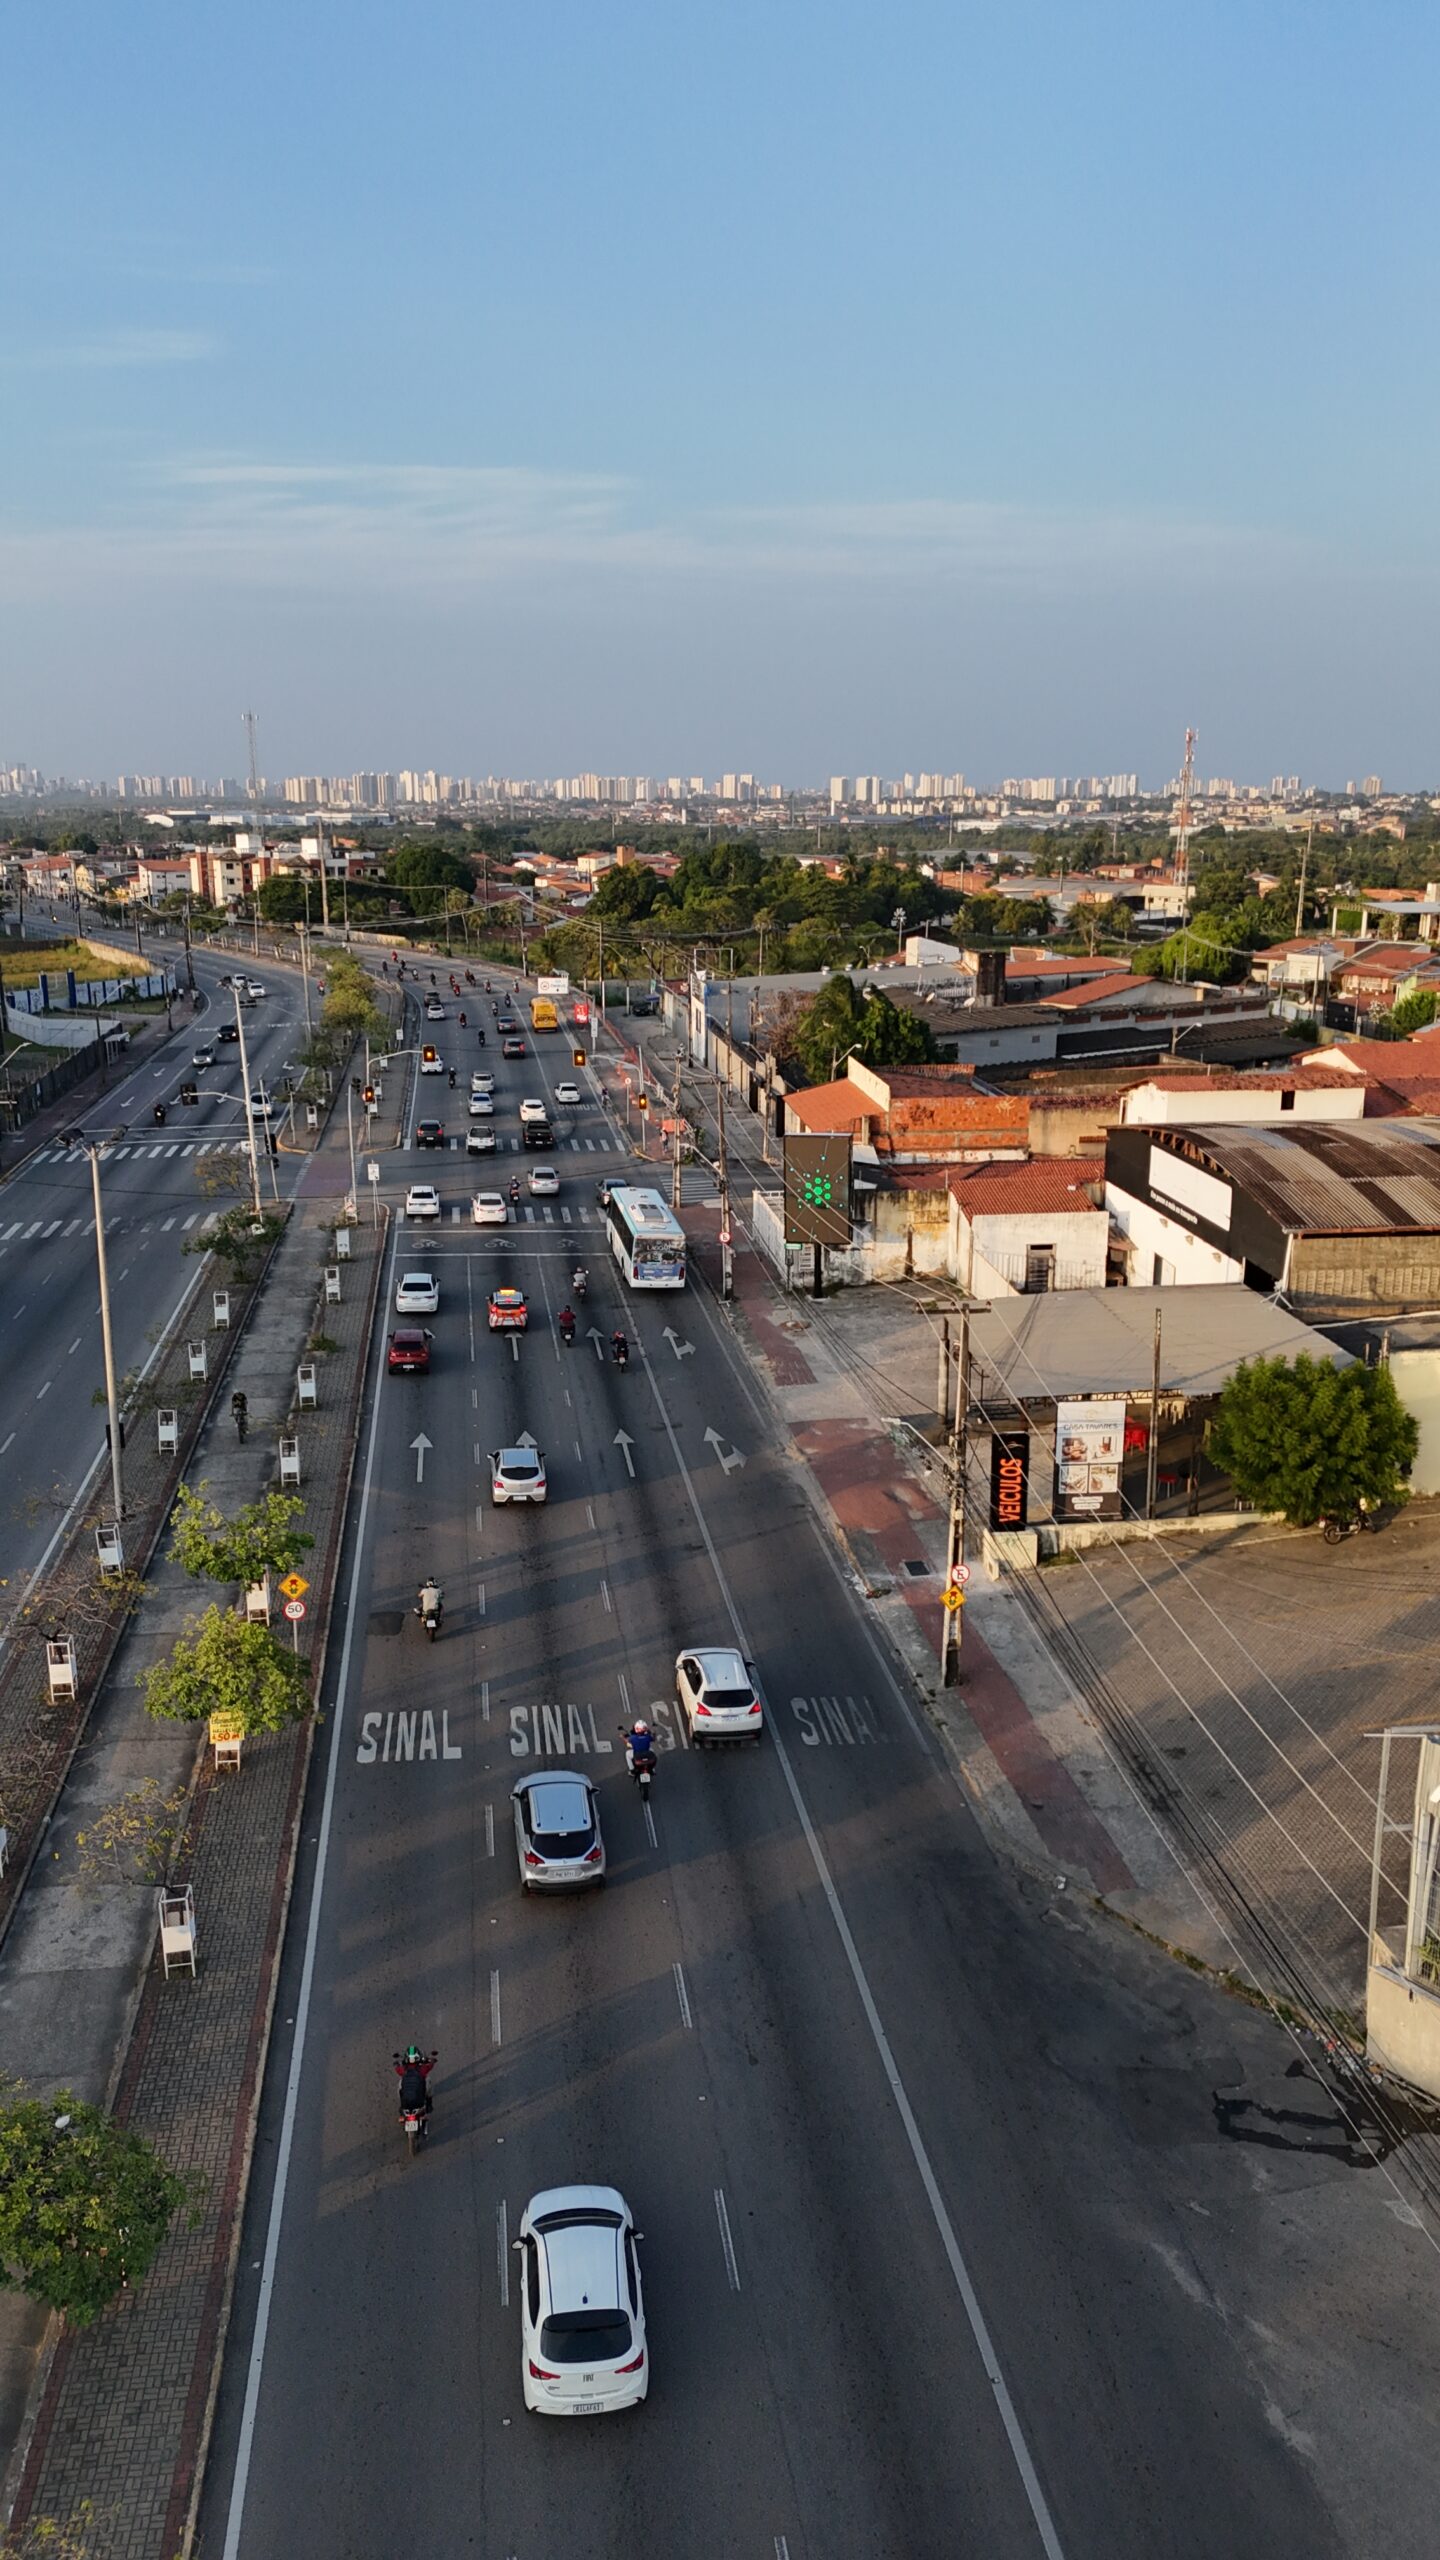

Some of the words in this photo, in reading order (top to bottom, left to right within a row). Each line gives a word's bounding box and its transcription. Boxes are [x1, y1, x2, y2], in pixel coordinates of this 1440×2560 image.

[1086, 1423, 1119, 1431] TAVARES
[288, 1605, 303, 1613] 50
[510, 1703, 612, 1756] SINAL
[217, 1732, 230, 1742] 50
[356, 1709, 462, 1763] SINAL
